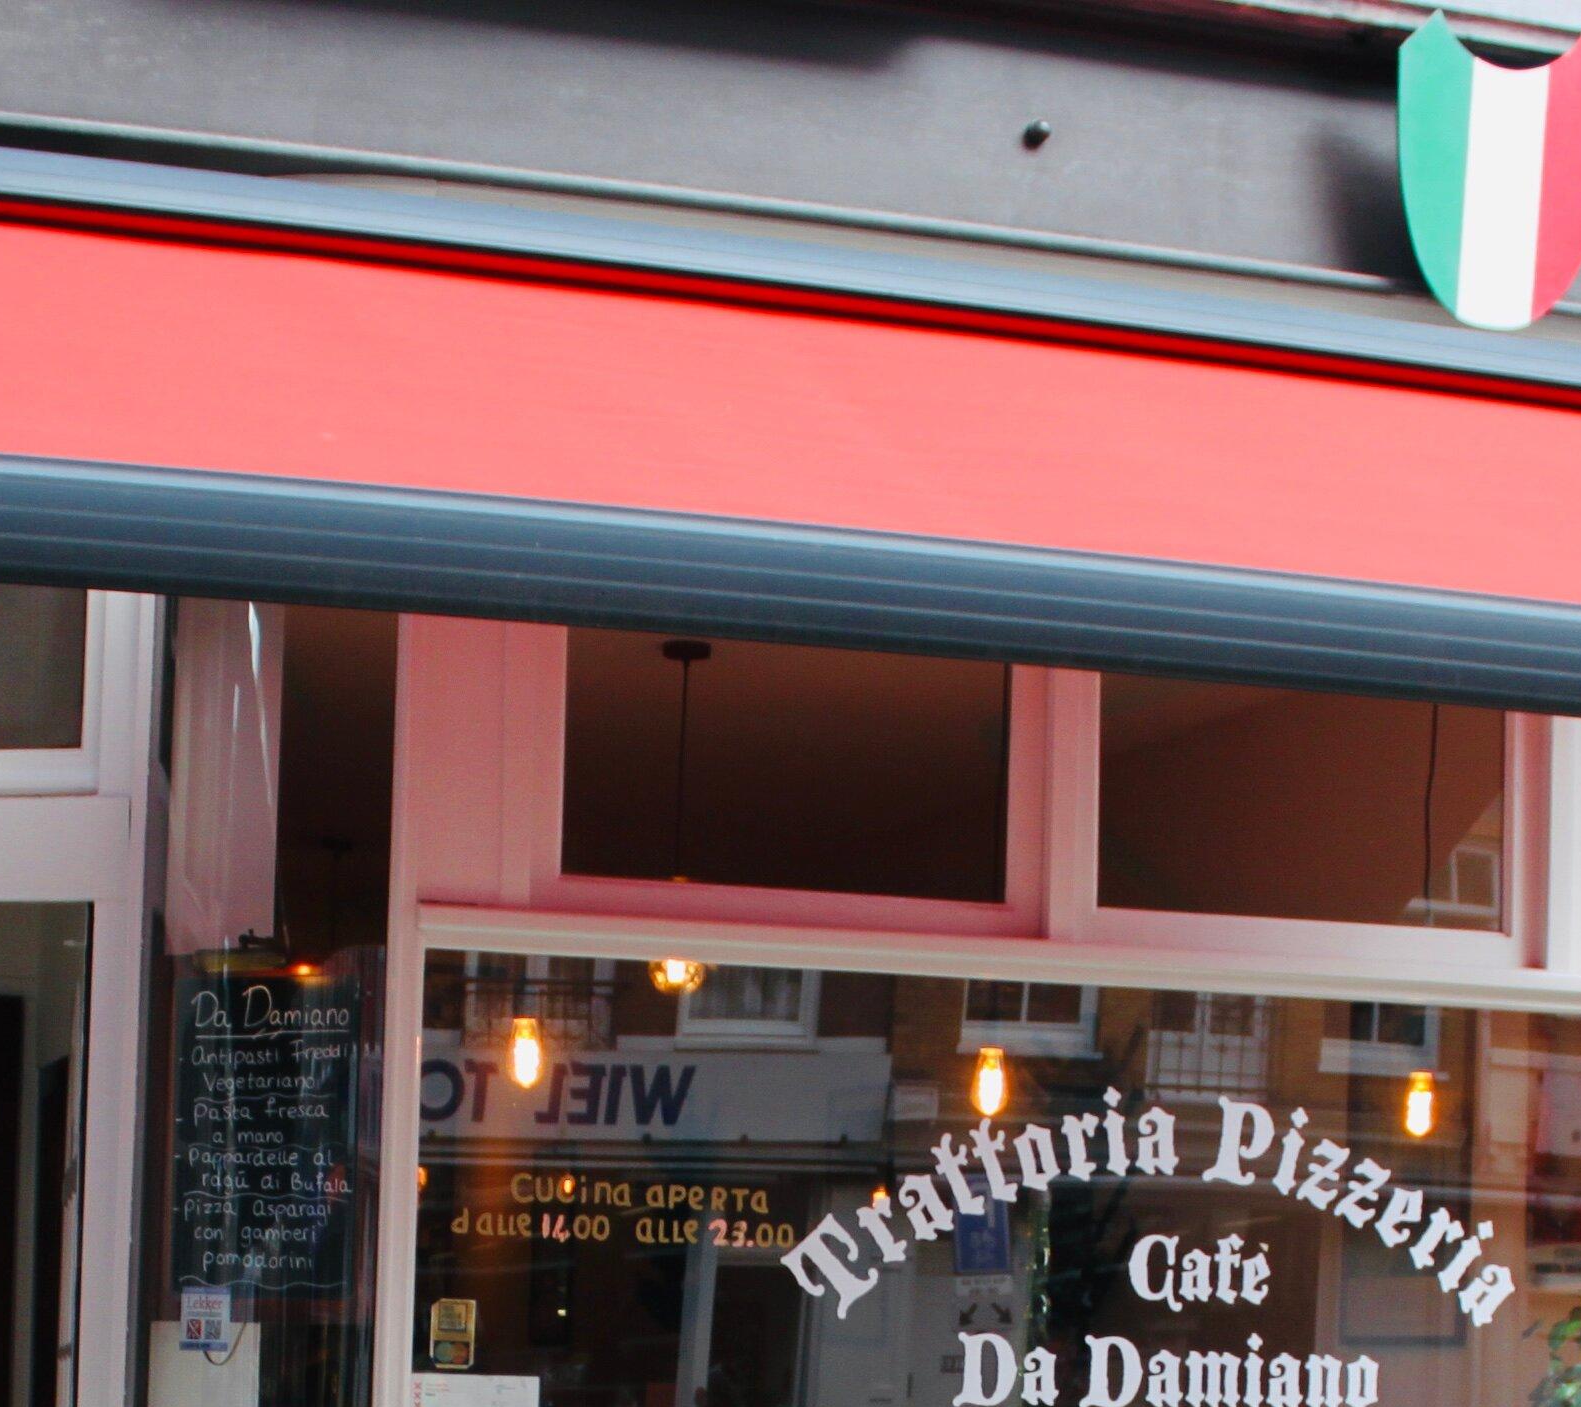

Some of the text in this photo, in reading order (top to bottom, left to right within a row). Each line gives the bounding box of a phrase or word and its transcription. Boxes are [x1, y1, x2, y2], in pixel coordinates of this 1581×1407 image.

[191, 985, 350, 1028] Da Damiano
[212, 1131, 284, 1144] a mano
[313, 1148, 334, 1166] al
[291, 1172, 352, 1194] Bufala
[781, 1086, 1516, 1328] Trattoria Pizzeria
[195, 1226, 317, 1248] con gamberi
[707, 1218, 796, 1249] 23.00
[952, 1331, 1060, 1407] Da
